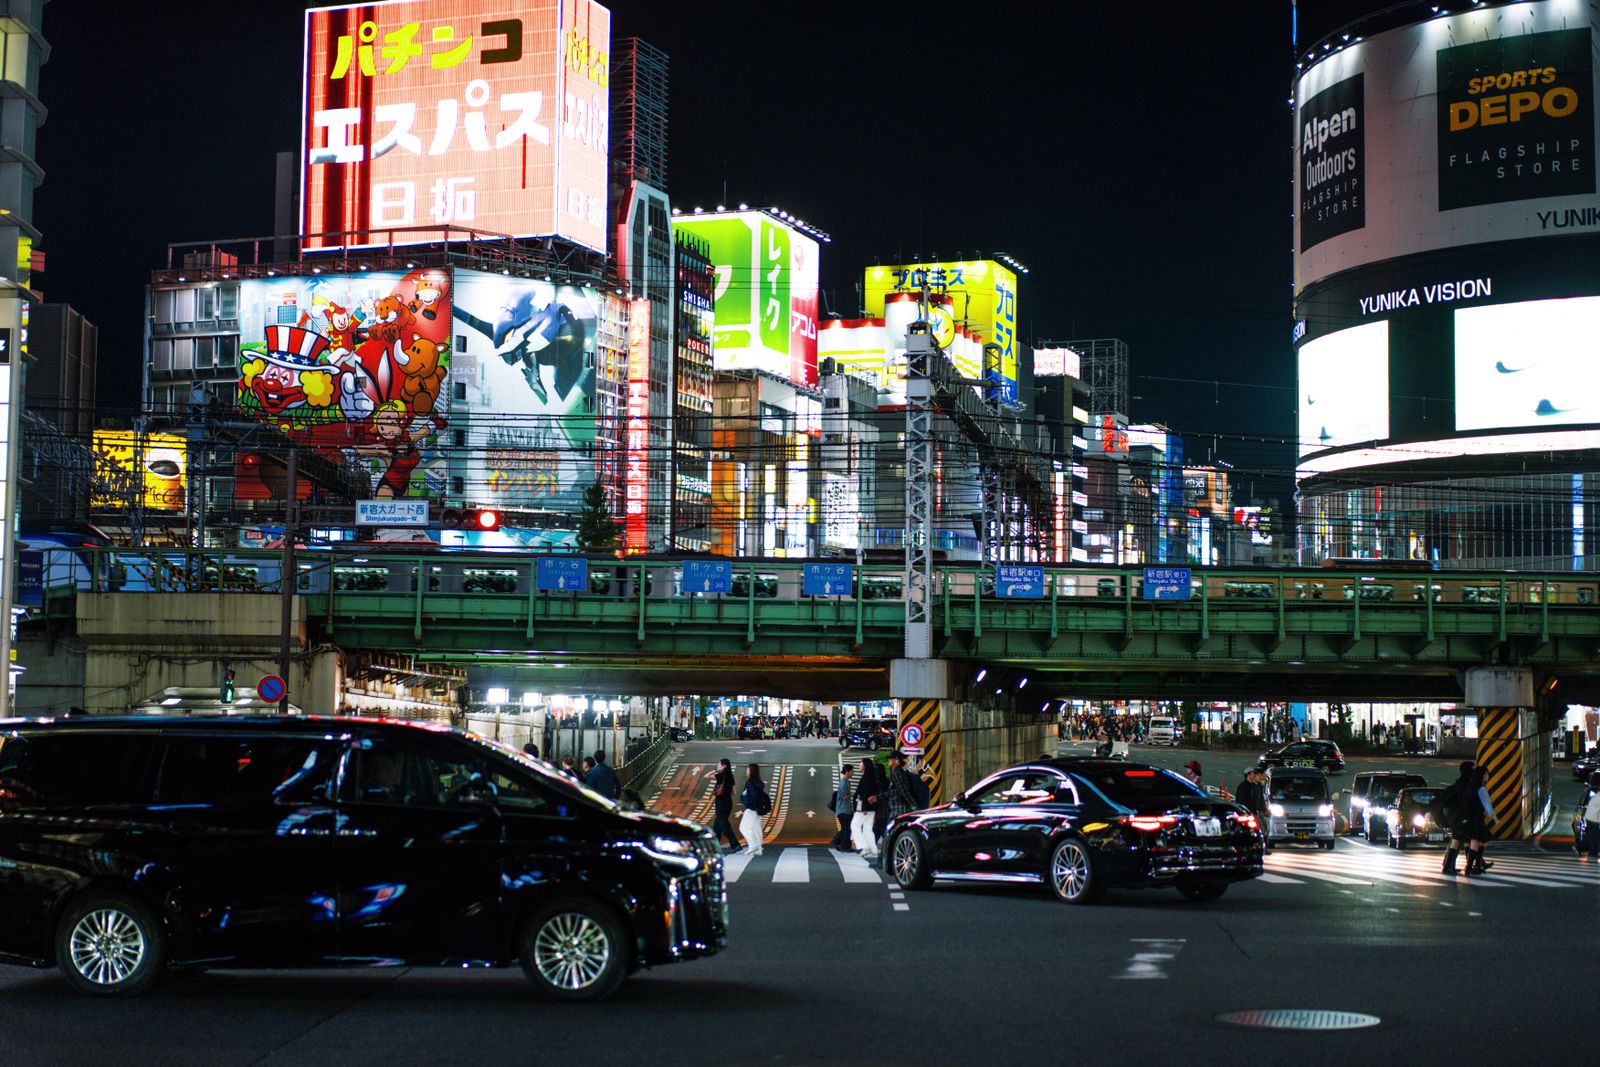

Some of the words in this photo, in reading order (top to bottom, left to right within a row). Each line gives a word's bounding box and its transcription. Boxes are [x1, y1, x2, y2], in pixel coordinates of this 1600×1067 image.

[330, 19, 523, 80] パチンコ
[565, 26, 608, 88] パチンコ
[1467, 66, 1558, 94] SPORTS
[308, 79, 550, 165] エスパス
[1450, 86, 1579, 132] DEPO
[1303, 106, 1356, 155] Alpen
[1450, 139, 1580, 167] FLAGSHIP
[1306, 147, 1356, 191] Outdoors
[1497, 158, 1580, 179] STORE
[1302, 178, 1358, 214] FLAGSHIP
[1318, 196, 1358, 221] STORE
[767, 226, 782, 332] レイク
[891, 268, 965, 289] プロミス
[683, 290, 710, 310] SHISHA
[1359, 288, 1420, 315] YUNIKA
[1423, 277, 1492, 304] VISION
[791, 310, 816, 340] アコム
[687, 338, 710, 355] POKER
[360, 503, 425, 515] 新宿大ガード西
[1000, 567, 1041, 577] 新宿駅東口
